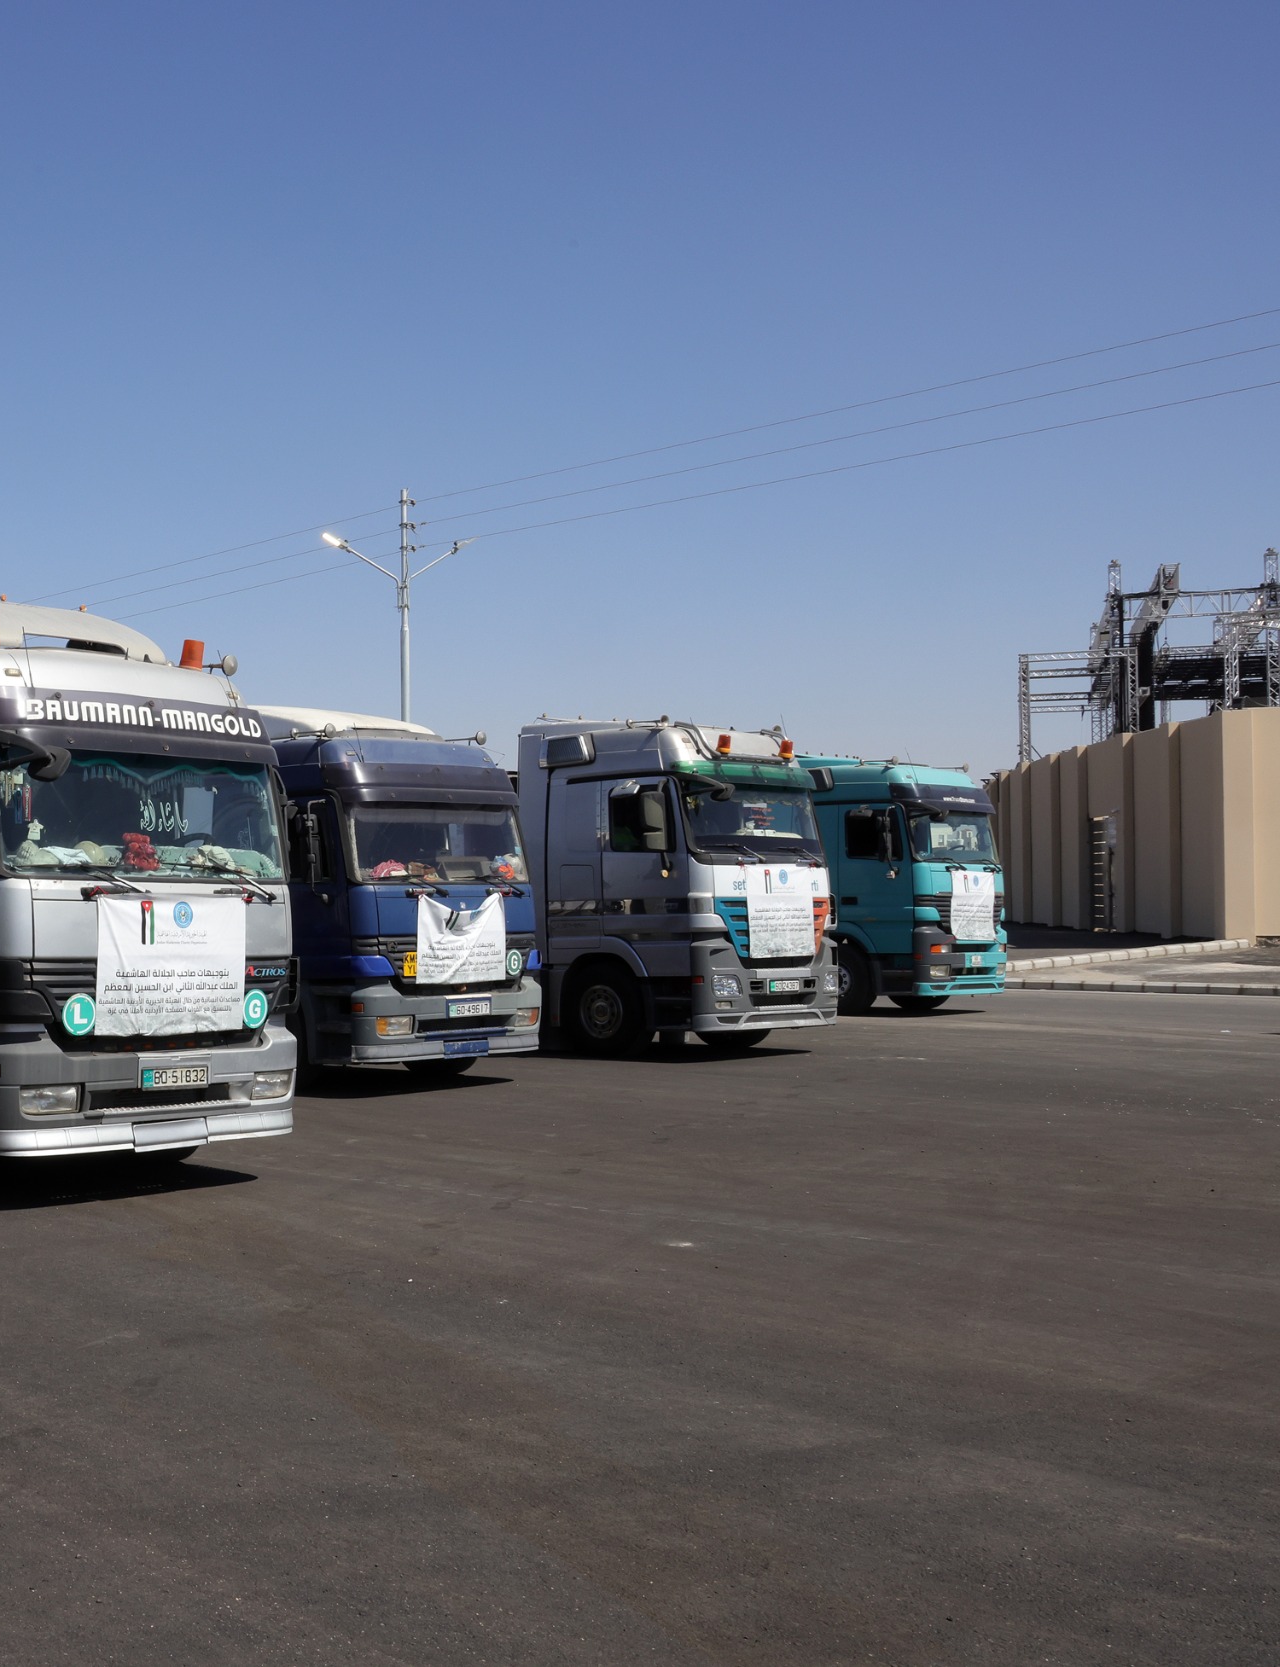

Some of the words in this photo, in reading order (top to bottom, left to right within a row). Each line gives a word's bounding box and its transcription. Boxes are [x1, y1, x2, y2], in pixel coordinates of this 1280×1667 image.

[26, 699, 262, 738] BAUMANN-MANGOLD
[404, 954, 418, 964] KM
[510, 955, 519, 969] G
[73, 1003, 88, 1025] L
[248, 999, 262, 1019] G
